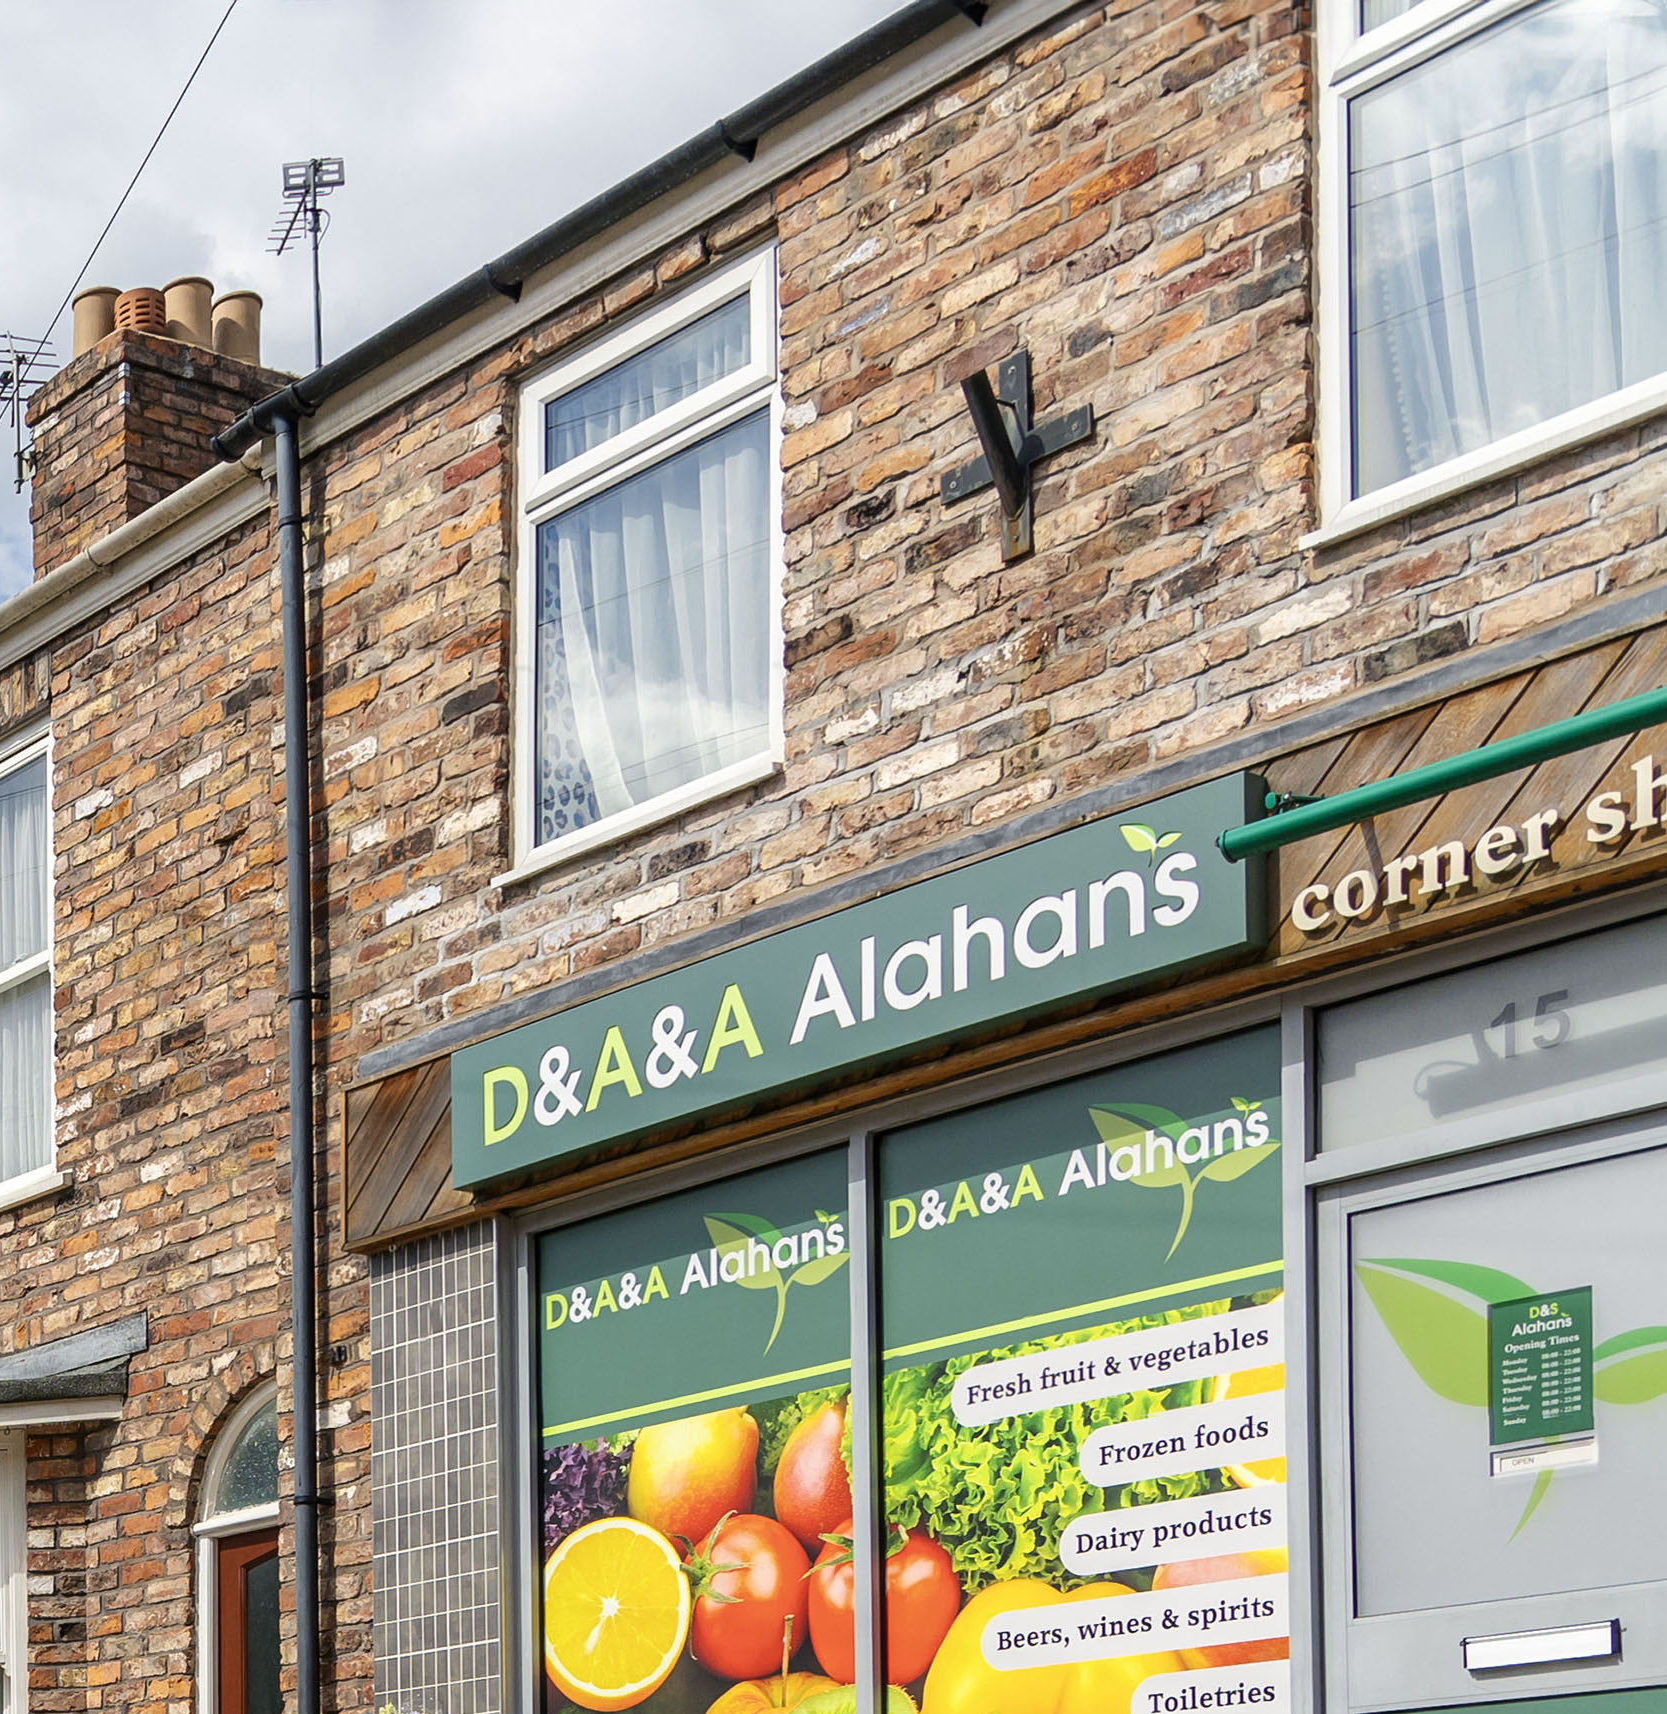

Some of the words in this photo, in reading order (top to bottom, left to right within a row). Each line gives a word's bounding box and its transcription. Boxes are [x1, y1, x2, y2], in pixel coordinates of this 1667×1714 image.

[1291, 808, 1559, 932] corner
[1489, 989, 1571, 1060] 15
[483, 983, 764, 1146] D&A&A
[888, 1163, 1045, 1240] D&A&A
[545, 1265, 670, 1331] D&A&A
[1529, 1302, 1559, 1319] D&S
[966, 1372, 1032, 1405] Fresh
[1038, 1360, 1097, 1391] fruit
[1103, 1355, 1122, 1377] &
[1128, 1328, 1269, 1372] vegetables
[1504, 1339, 1547, 1354] Opening
[1547, 1334, 1580, 1345] Times
[1098, 1435, 1187, 1466] Frozen
[1194, 1415, 1270, 1449] foods
[1075, 1526, 1145, 1555] Dairy
[1152, 1506, 1273, 1548] products
[996, 1625, 1071, 1651] Beers,
[1077, 1615, 1153, 1641] wines
[1161, 1608, 1180, 1630] &
[1187, 1596, 1275, 1631] spirits
[1148, 1682, 1276, 1714] Toiletries
